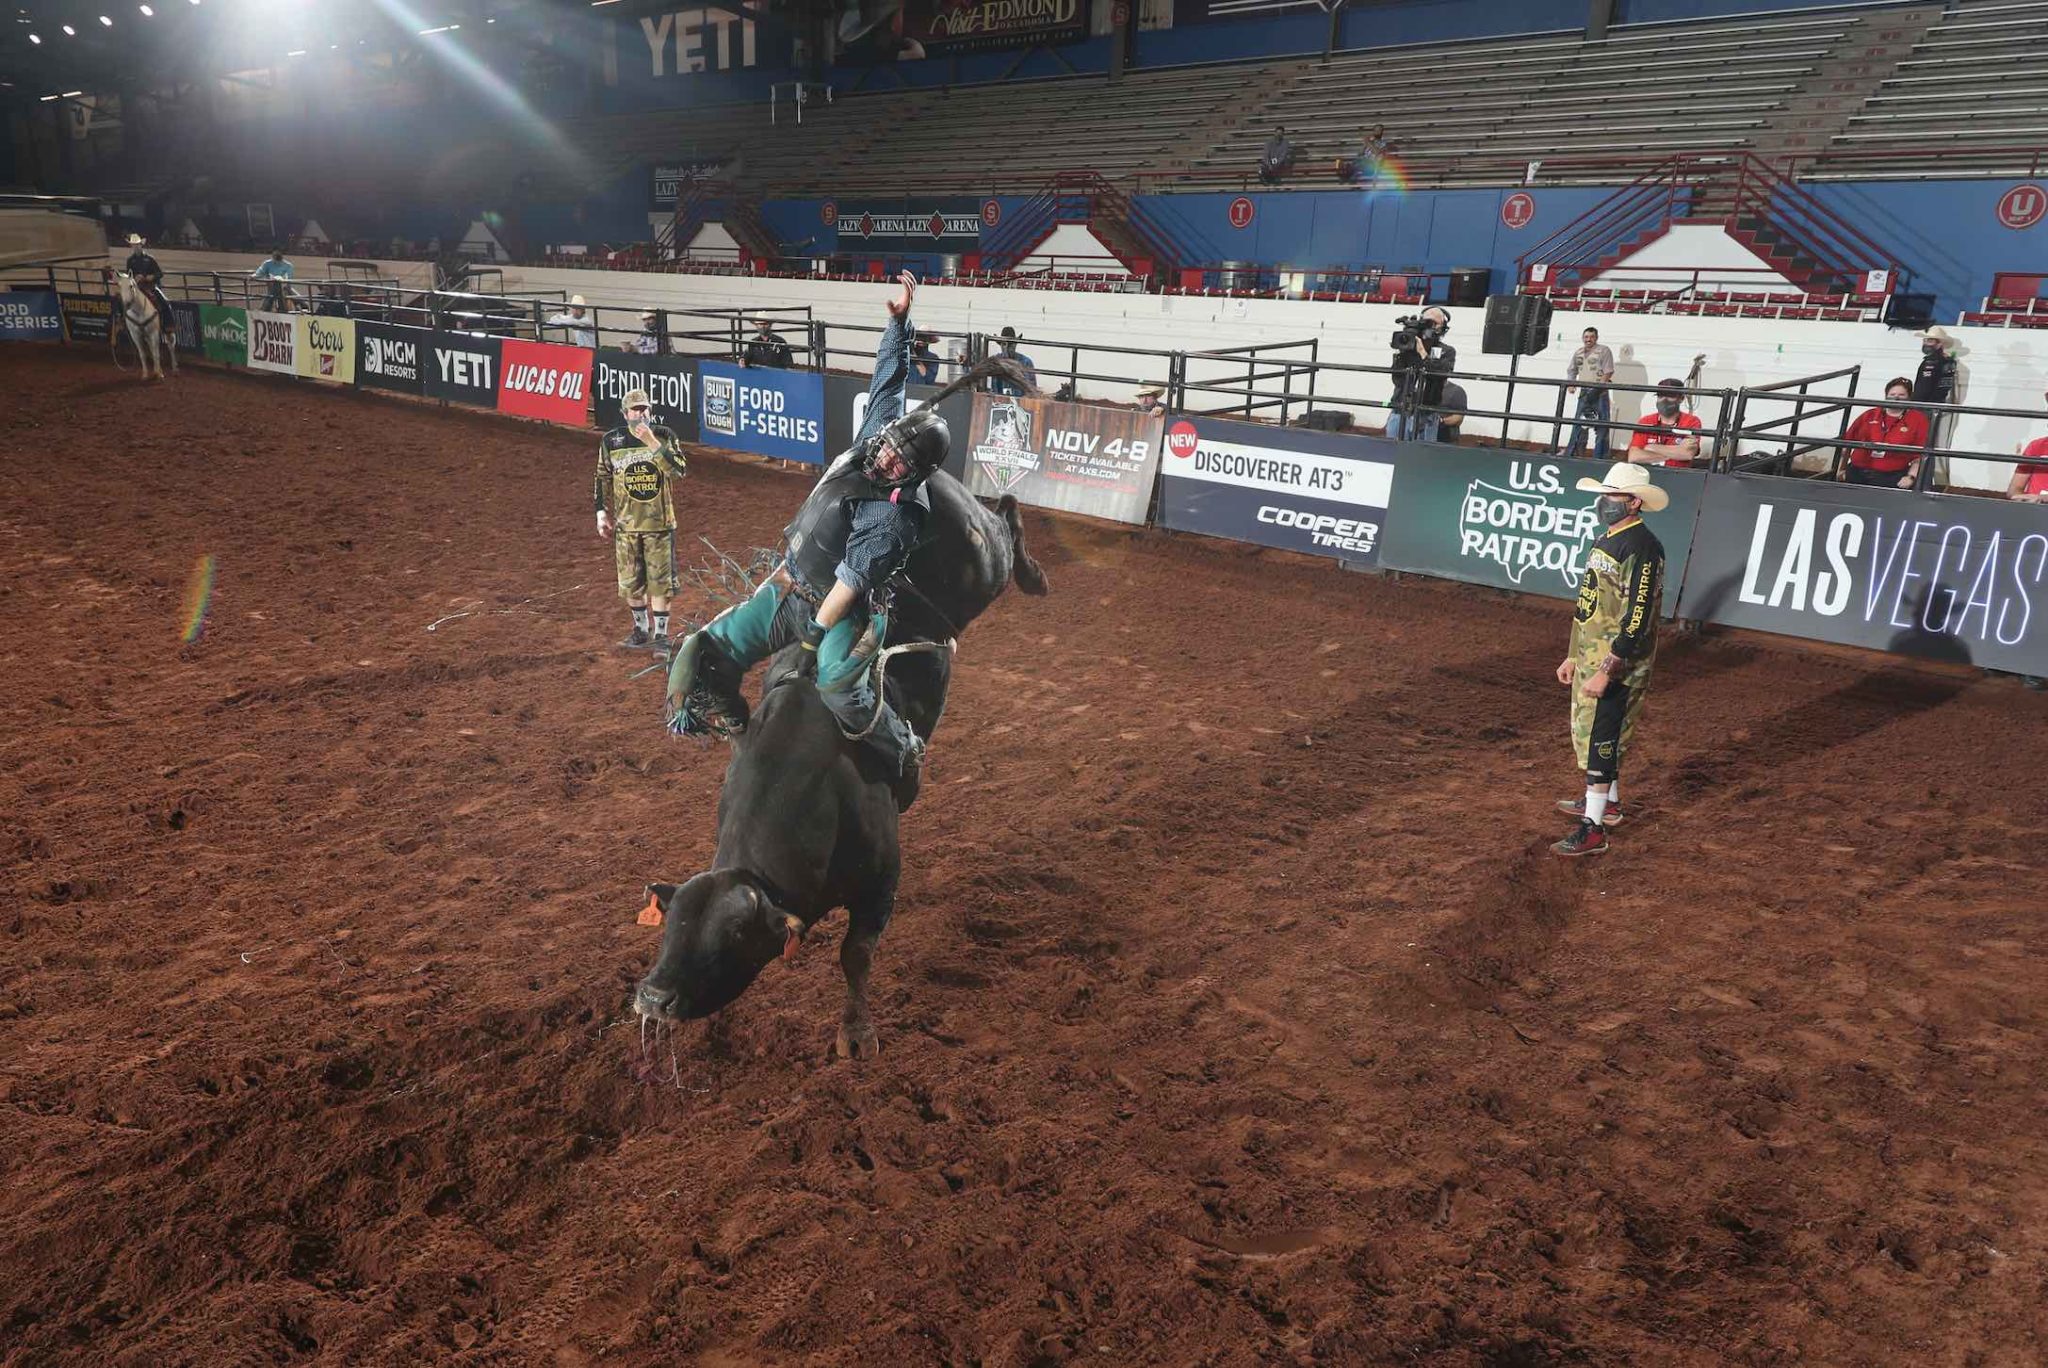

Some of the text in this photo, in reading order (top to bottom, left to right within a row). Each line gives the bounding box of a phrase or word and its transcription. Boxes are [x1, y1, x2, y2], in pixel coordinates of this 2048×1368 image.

[929, 0, 1077, 36] Visit EDMOND
[640, 8, 756, 77] YETI
[656, 181, 678, 196] LAZY
[1236, 203, 1247, 219] T
[1512, 199, 1526, 219] T
[2011, 194, 2036, 216] U
[838, 219, 904, 232] LAZY ARENA
[906, 219, 979, 232] LAZY ARENA
[0, 303, 29, 316] ORD
[0, 315, 59, 329] -SERIES
[267, 321, 292, 343] BOOT
[308, 320, 344, 353] Coors
[269, 342, 293, 366] BARN
[383, 338, 416, 366] MGM
[384, 365, 417, 380] RESORTS
[435, 347, 492, 389] YETI
[504, 363, 584, 401] LUCAS OIL
[706, 382, 732, 399] BUILT
[739, 385, 785, 413] FORD
[706, 413, 732, 429] TOUGH
[739, 410, 819, 444] F-SERIES
[1045, 428, 1149, 462] NOV 4-8
[1169, 433, 1196, 448] NEW
[978, 446, 1036, 463] WORLD FINALS
[1050, 451, 1142, 473] TICKETS AVAILABLE
[633, 465, 649, 473] U.S.
[1064, 463, 1121, 480] AT AXS.COM
[1194, 450, 1303, 486] DISCOVERER
[1508, 460, 1565, 495] U.S.
[627, 483, 659, 492] PATROL
[1256, 505, 1379, 542] COOPER
[1465, 495, 1600, 541] BORDER
[1310, 531, 1375, 554] TIRES
[1461, 529, 1587, 575] PATROL
[1636, 561, 1652, 604] PATROL
[1738, 503, 2048, 645] LAS VEGAS
